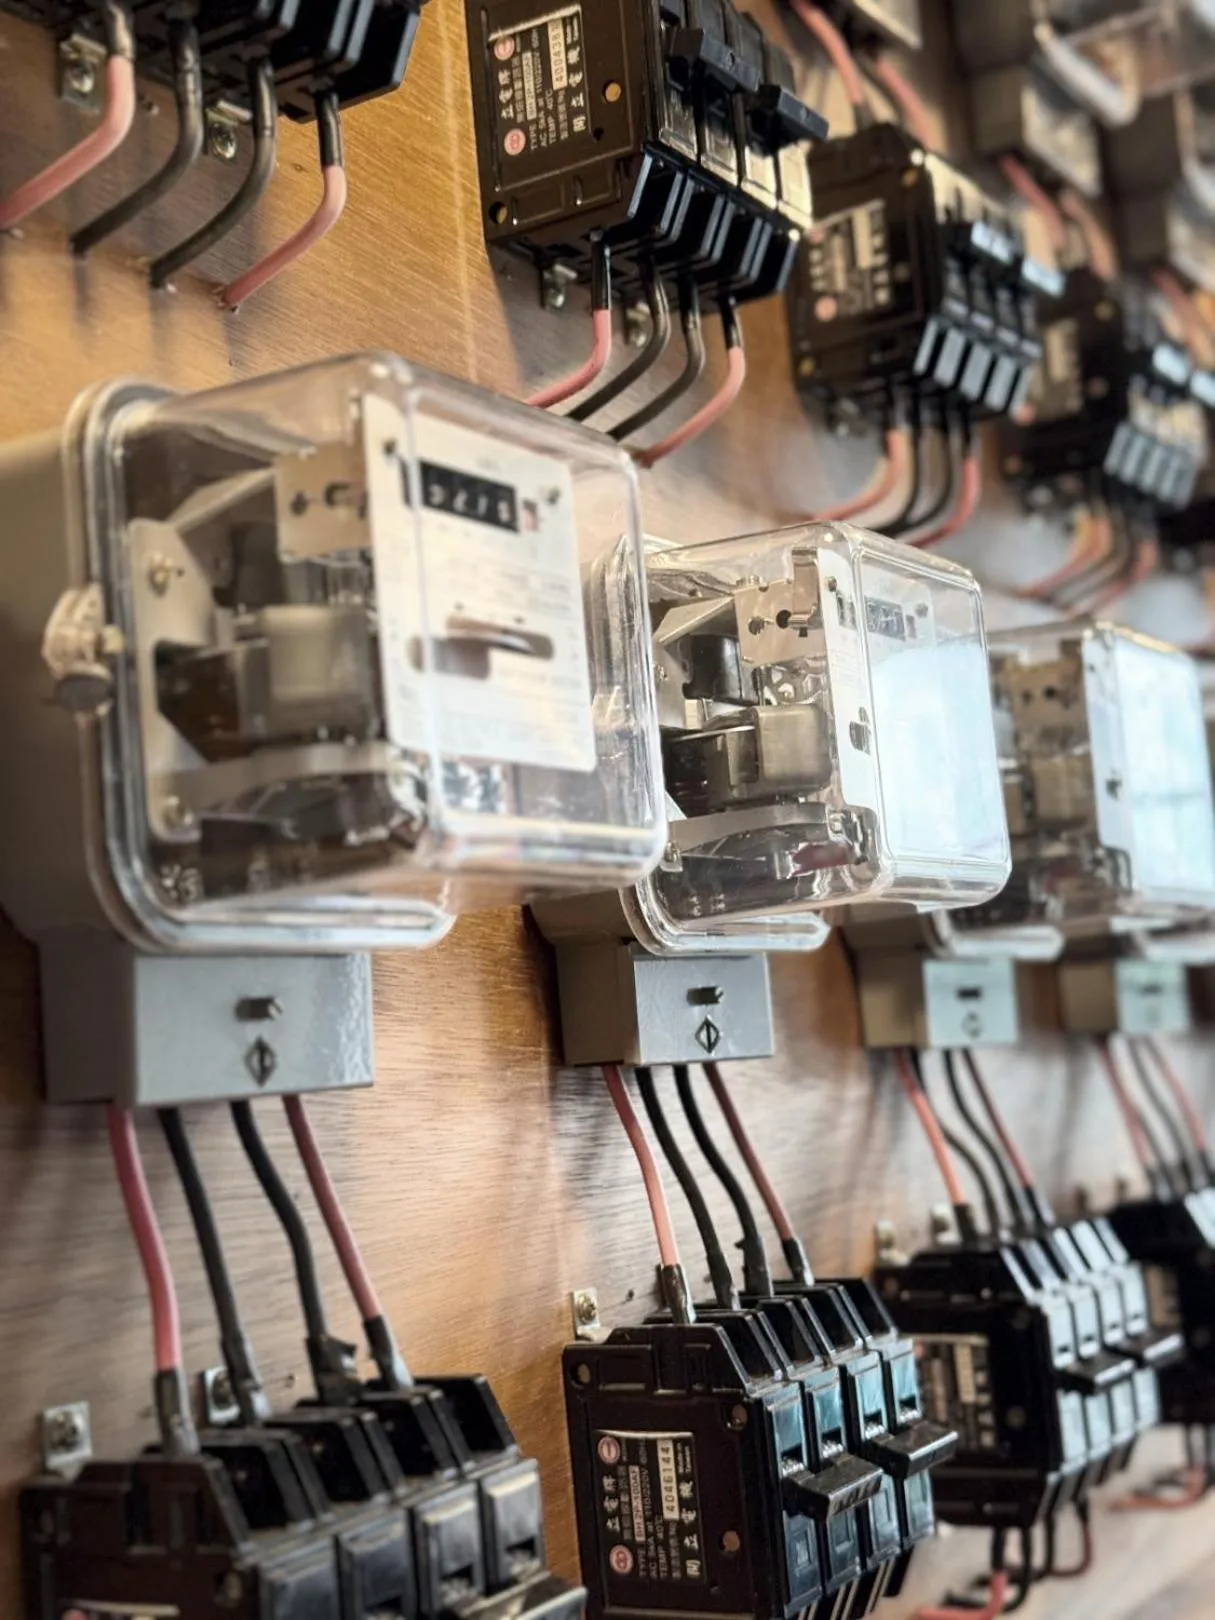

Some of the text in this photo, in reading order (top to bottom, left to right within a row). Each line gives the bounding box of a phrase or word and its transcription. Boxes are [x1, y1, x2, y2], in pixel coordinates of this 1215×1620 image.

[547, 115, 556, 144] TEMP
[661, 1446, 675, 1513] 4046144
[650, 1562, 658, 1578] AC
[658, 1545, 667, 1578] TEMP
